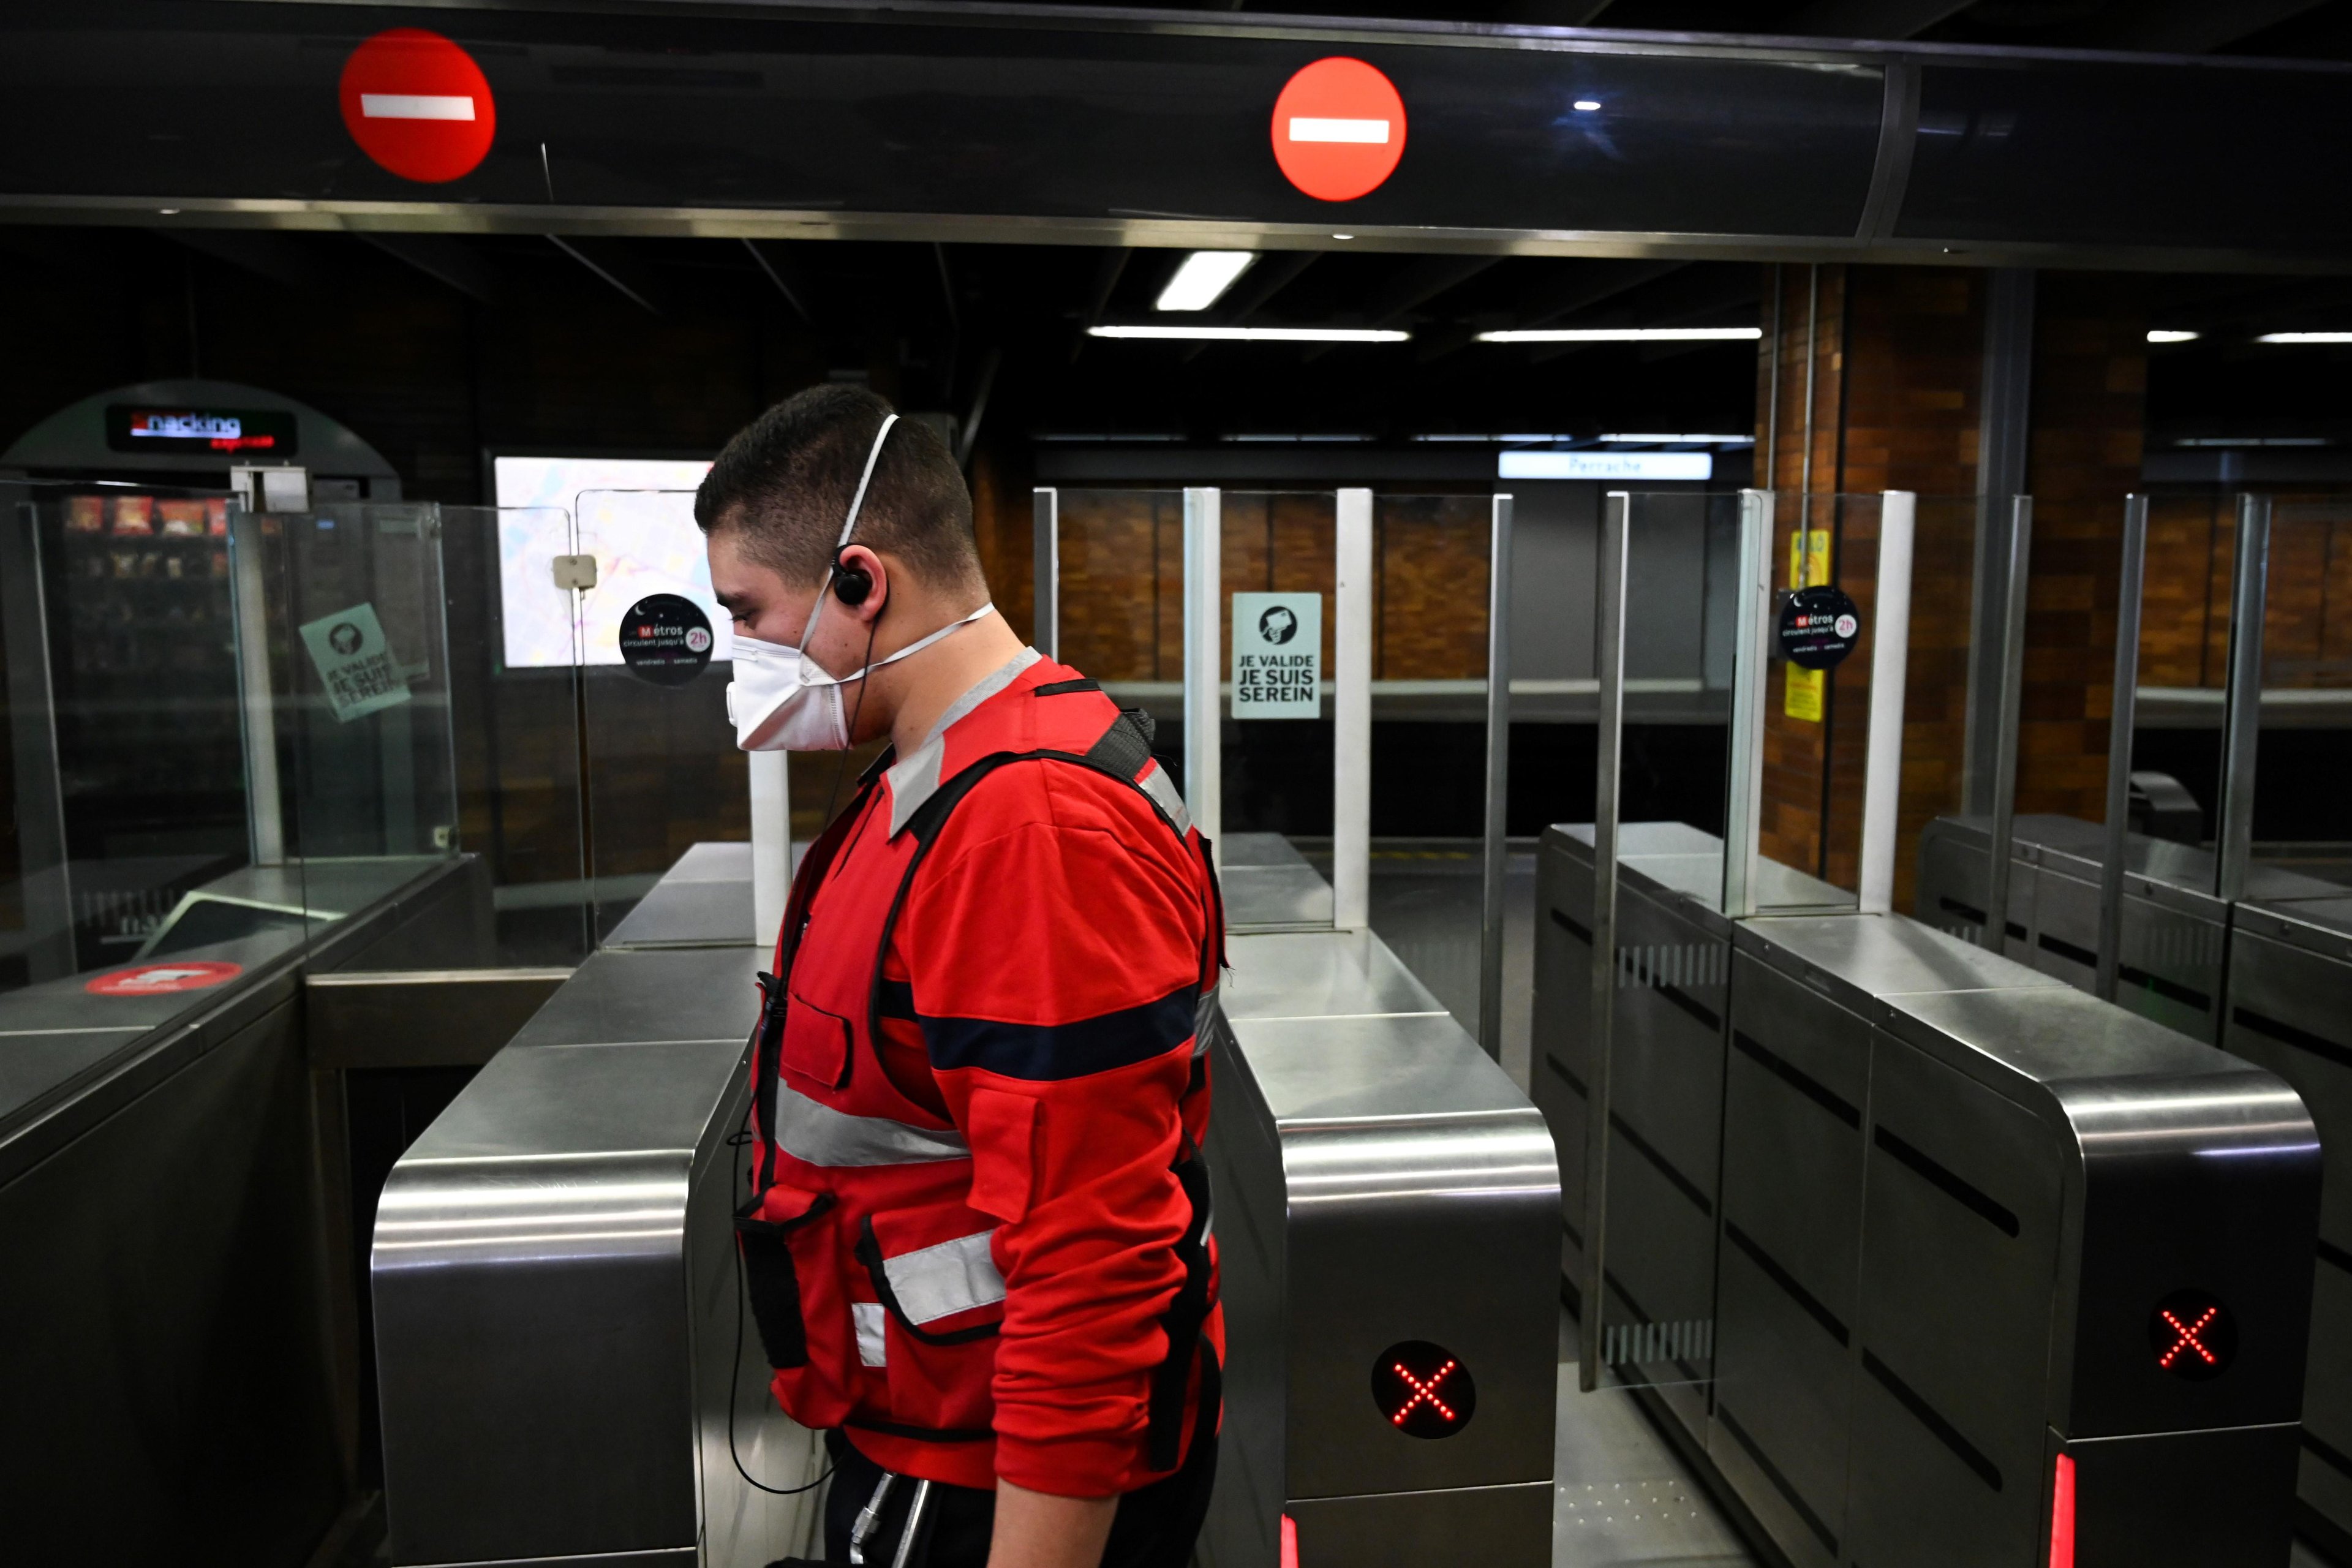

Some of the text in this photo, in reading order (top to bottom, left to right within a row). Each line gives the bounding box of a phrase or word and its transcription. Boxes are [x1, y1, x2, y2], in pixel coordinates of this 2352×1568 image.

[1797, 613, 1834, 626] Métros
[1839, 619, 1853, 631] 2h
[641, 624, 684, 638] Métros
[690, 632, 707, 644] 2h
[1239, 655, 1314, 667] JE VALIDE
[1239, 669, 1313, 685] JE SUIS
[1239, 687, 1313, 702] SEREIN
